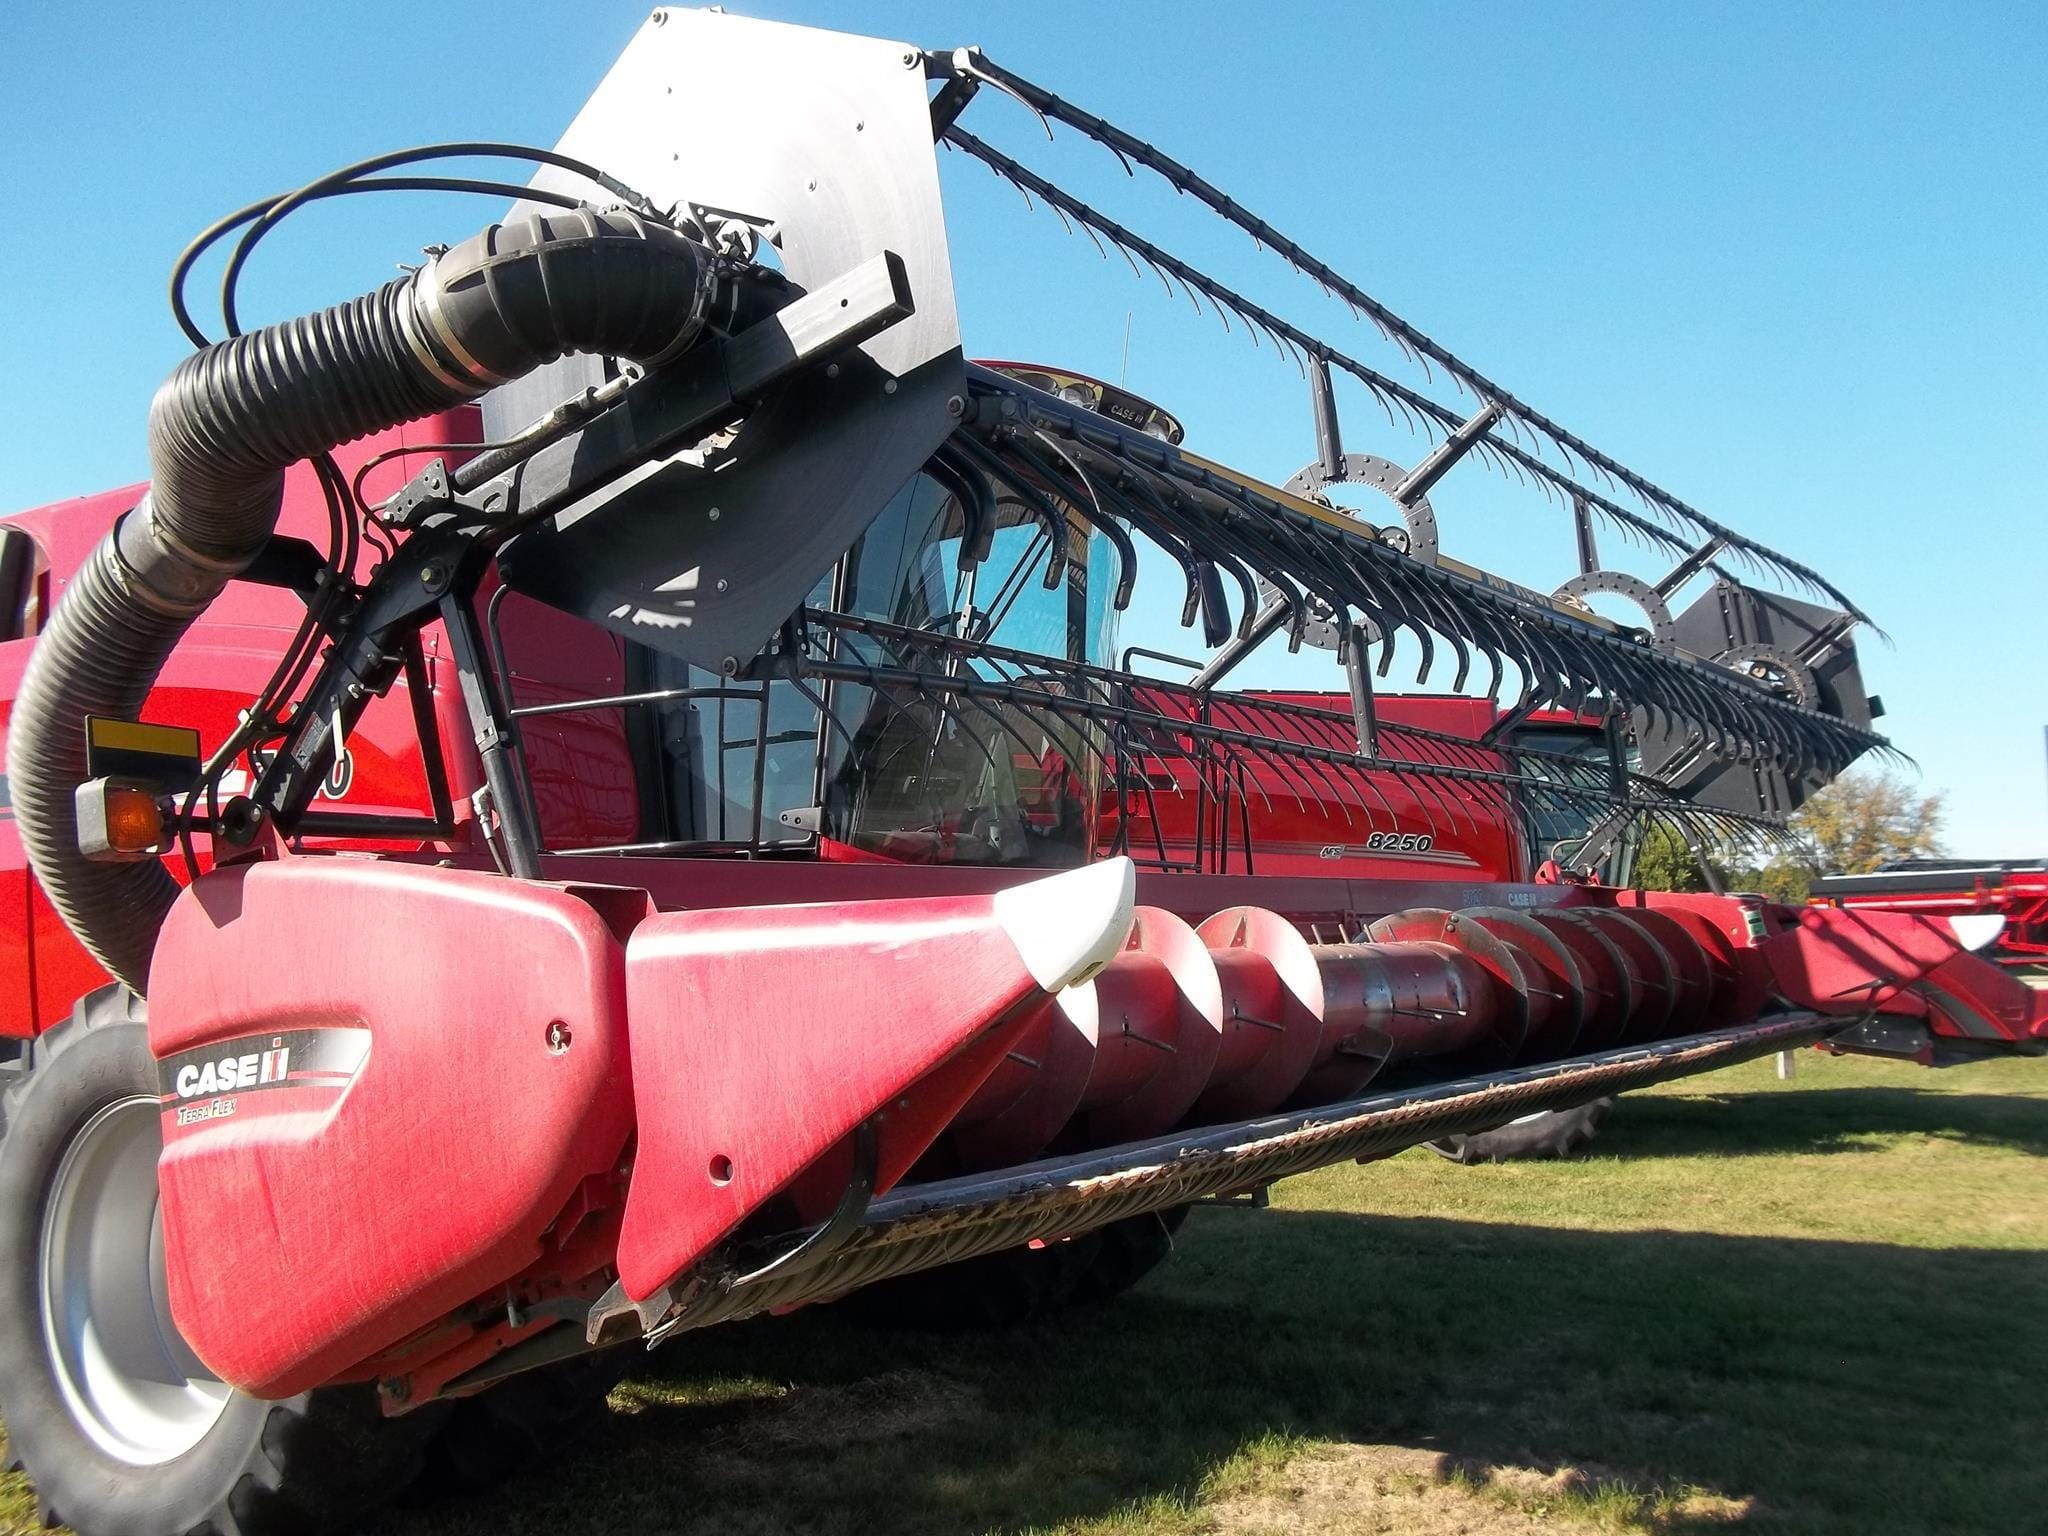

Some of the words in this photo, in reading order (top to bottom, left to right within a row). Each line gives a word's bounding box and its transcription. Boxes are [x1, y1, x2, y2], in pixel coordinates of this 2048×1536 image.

[1110, 404, 1133, 421] CASE
[1366, 831, 1433, 853] 8250
[1320, 846, 1342, 859] AFS
[1508, 893, 1529, 907] CASE
[177, 1054, 259, 1098] CASE
